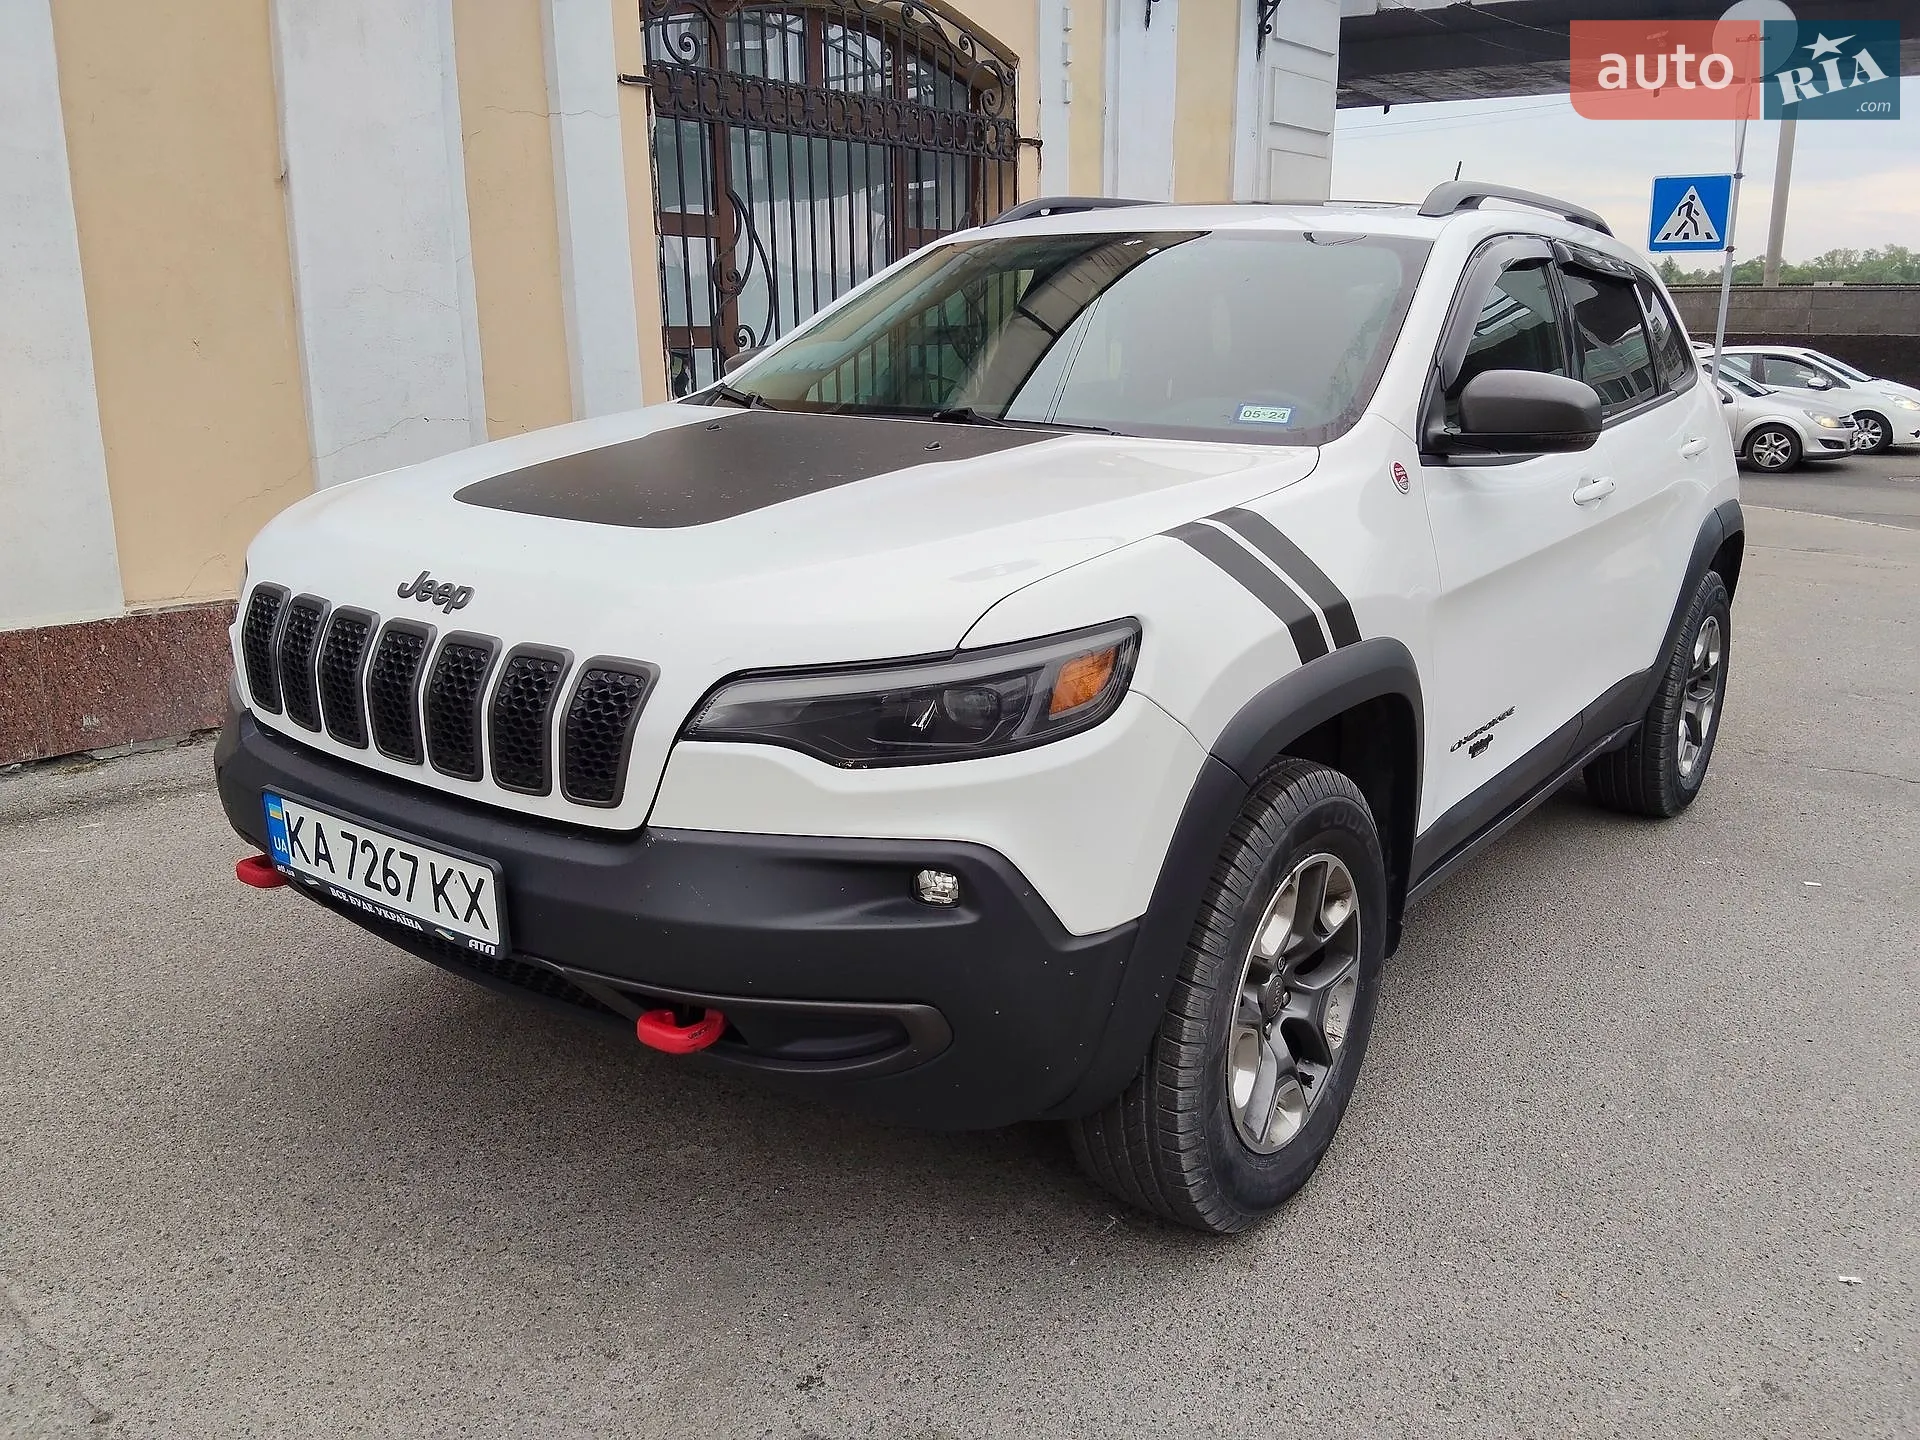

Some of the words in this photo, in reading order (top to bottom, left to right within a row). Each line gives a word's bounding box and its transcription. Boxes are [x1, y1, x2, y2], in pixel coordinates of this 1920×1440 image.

[397, 570, 475, 615] Jeep
[273, 836, 288, 854] UA
[285, 810, 336, 874] KA
[340, 830, 419, 903] 7267
[429, 861, 491, 931] KX
